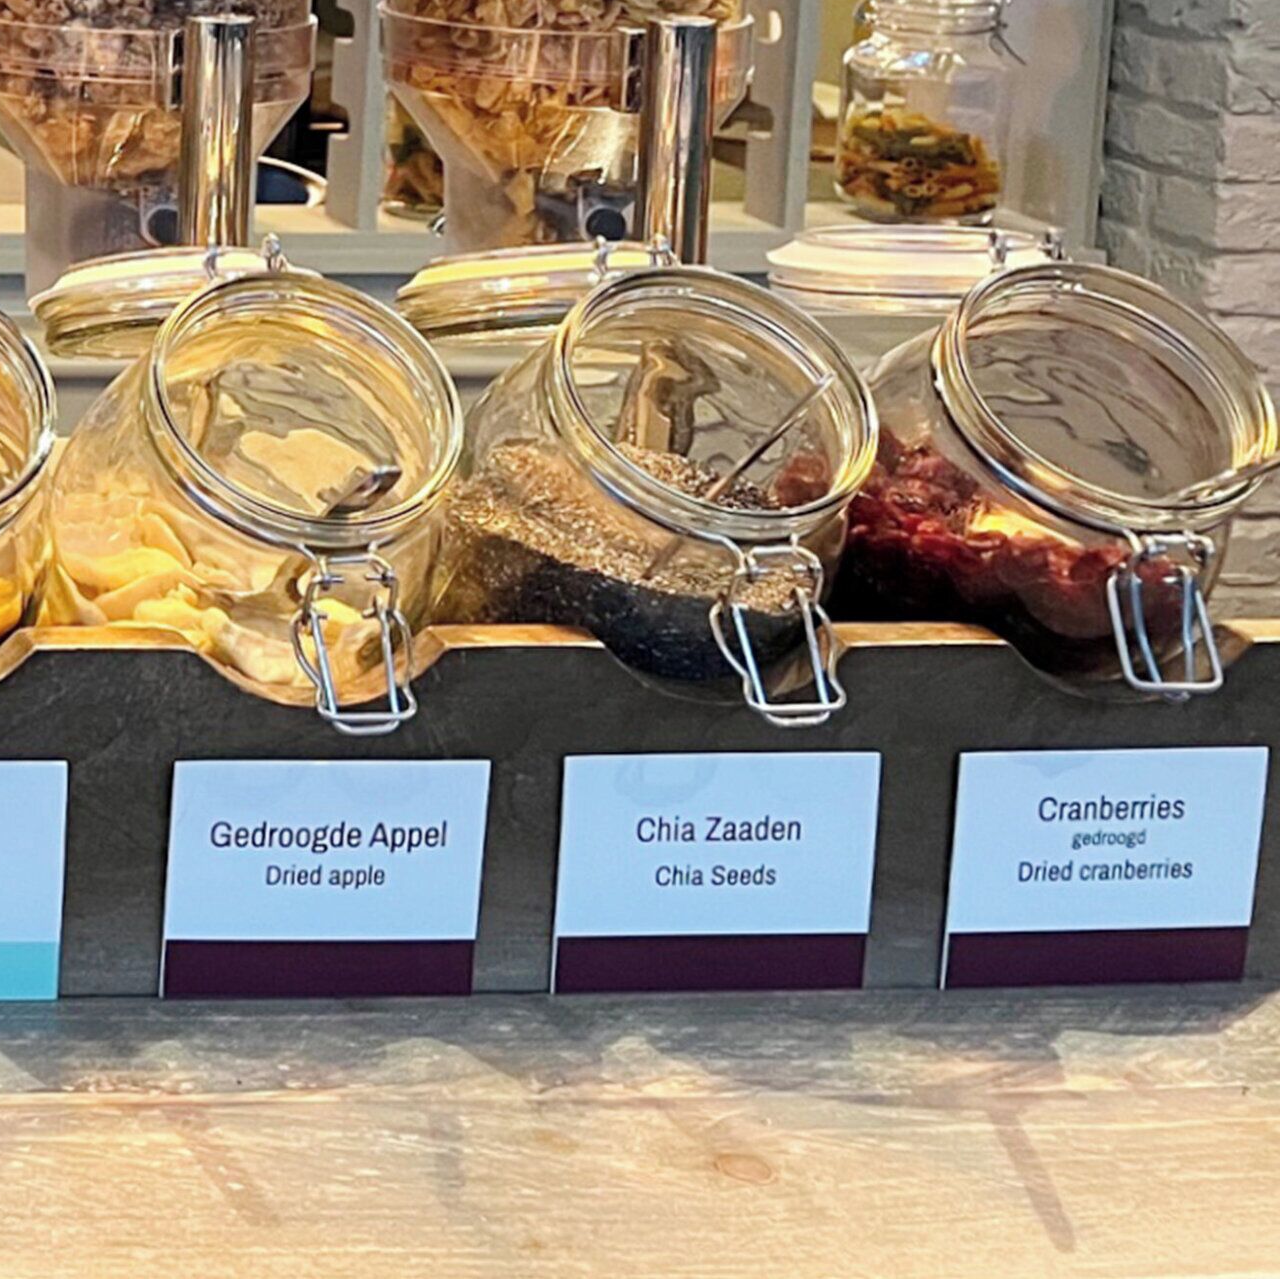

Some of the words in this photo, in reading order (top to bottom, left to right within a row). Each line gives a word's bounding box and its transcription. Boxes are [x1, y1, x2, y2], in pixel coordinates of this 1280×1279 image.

[1038, 793, 1186, 823] Cranberries
[210, 820, 363, 855] Gedroogde
[368, 819, 448, 854] Appel
[636, 815, 696, 843] Chia
[704, 814, 802, 842] Zaaden
[1071, 829, 1146, 851] gedroogd
[265, 864, 323, 887] Dried
[328, 864, 386, 890] apple
[655, 864, 704, 887] Chia
[710, 863, 777, 886] Seeds
[1017, 860, 1074, 883] Dried
[1079, 859, 1193, 882] cranberries
